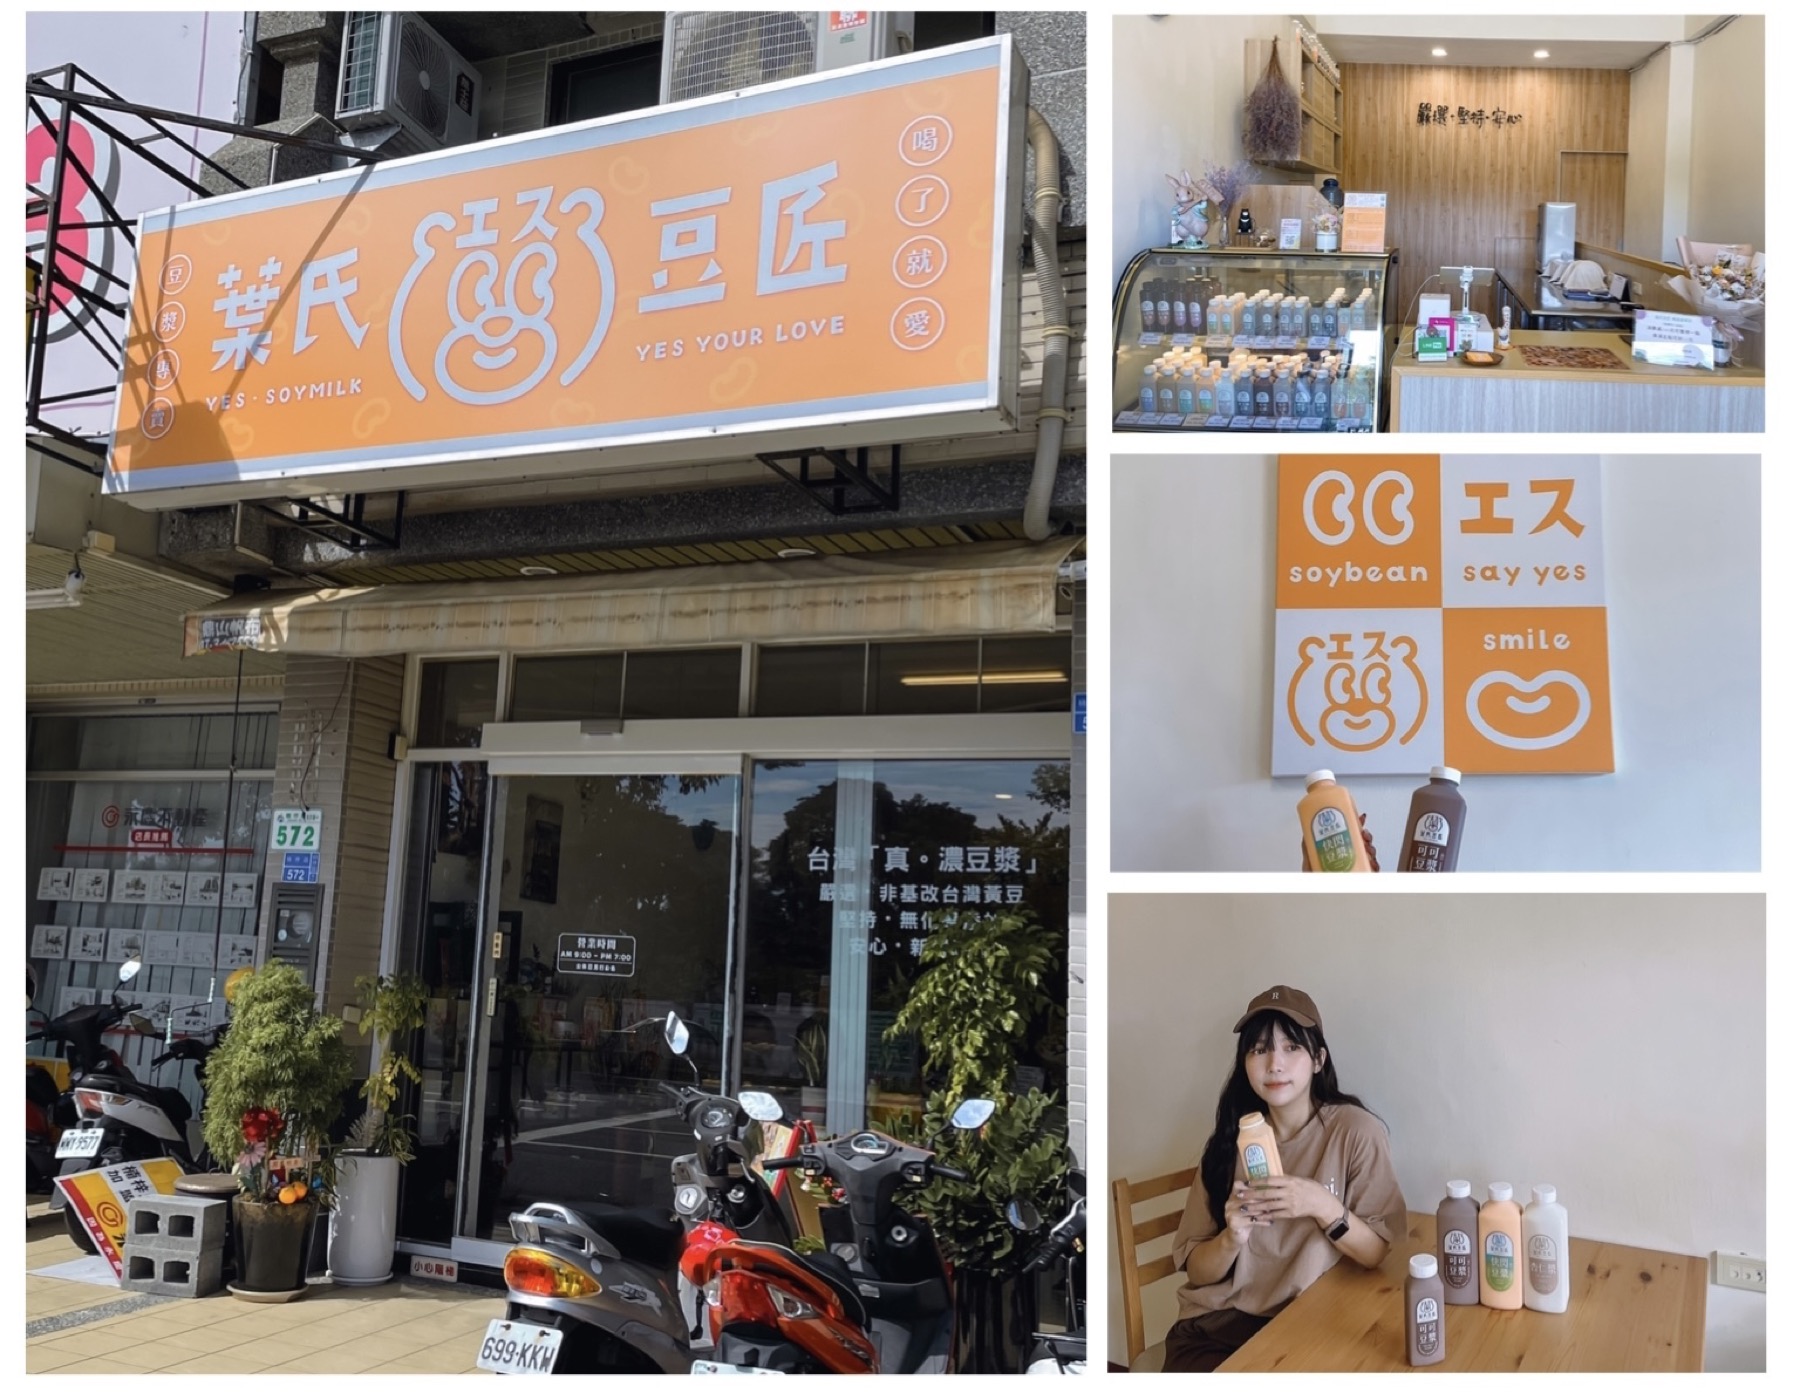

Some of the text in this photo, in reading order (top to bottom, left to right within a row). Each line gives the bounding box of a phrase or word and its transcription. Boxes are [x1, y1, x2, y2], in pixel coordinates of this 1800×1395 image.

[456, 186, 559, 249] エス
[211, 160, 849, 372] 葉氏 豆匠
[636, 315, 846, 362] YES YOUR LOVE
[206, 393, 247, 412] YES
[266, 378, 364, 405] SOYMILK
[1459, 478, 1586, 539] エス
[1288, 561, 1429, 588] soybean
[1463, 564, 1587, 587] say yes
[1483, 628, 1571, 651] smile
[276, 825, 315, 847] 572
[1418, 845, 1440, 858] 可可
[286, 868, 306, 881] 572
[577, 936, 617, 950] 營業時間
[561, 950, 573, 958] AM
[614, 953, 632, 962] 7:00
[121, 1165, 150, 1197] 楠梓
[414, 1260, 455, 1277] 小心階梯
